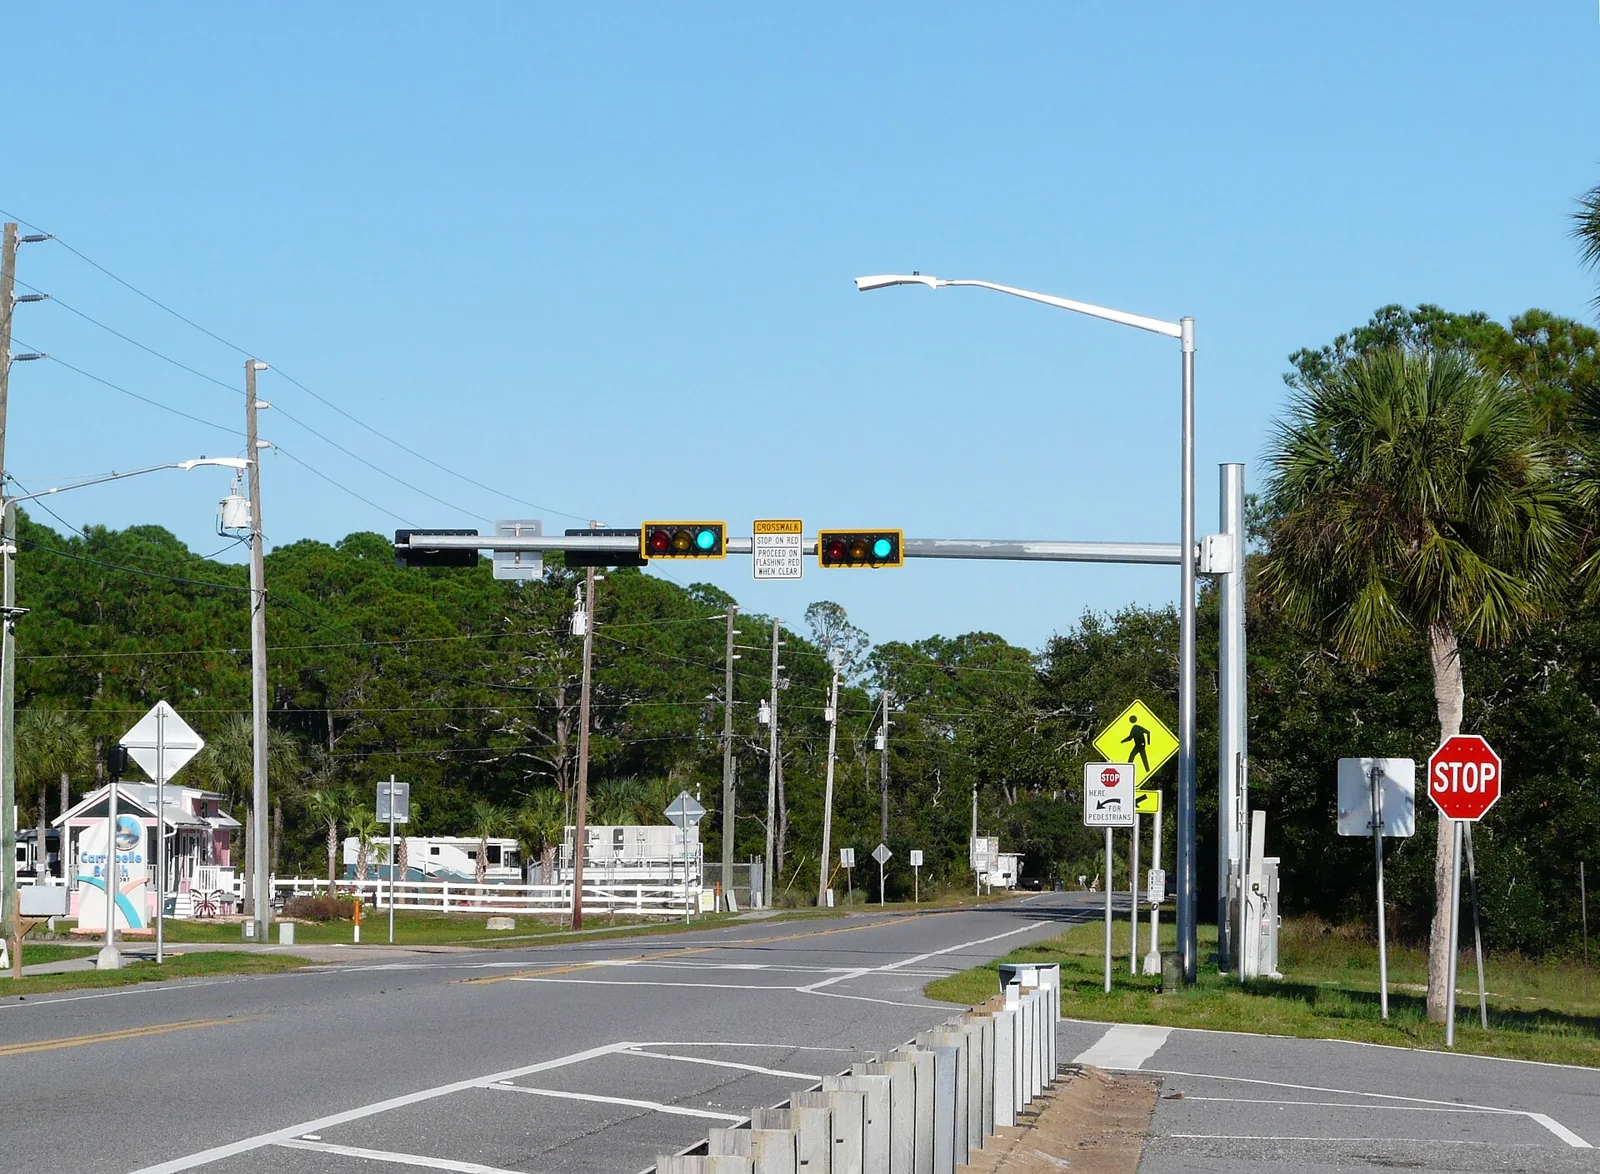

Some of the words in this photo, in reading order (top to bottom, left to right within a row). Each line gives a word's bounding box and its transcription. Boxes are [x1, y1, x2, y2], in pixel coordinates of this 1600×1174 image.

[757, 523, 799, 531] CROSSWALK
[1101, 773, 1120, 782] STOP
[1433, 761, 1496, 793] STOP
[81, 851, 142, 863] Carrbelle
